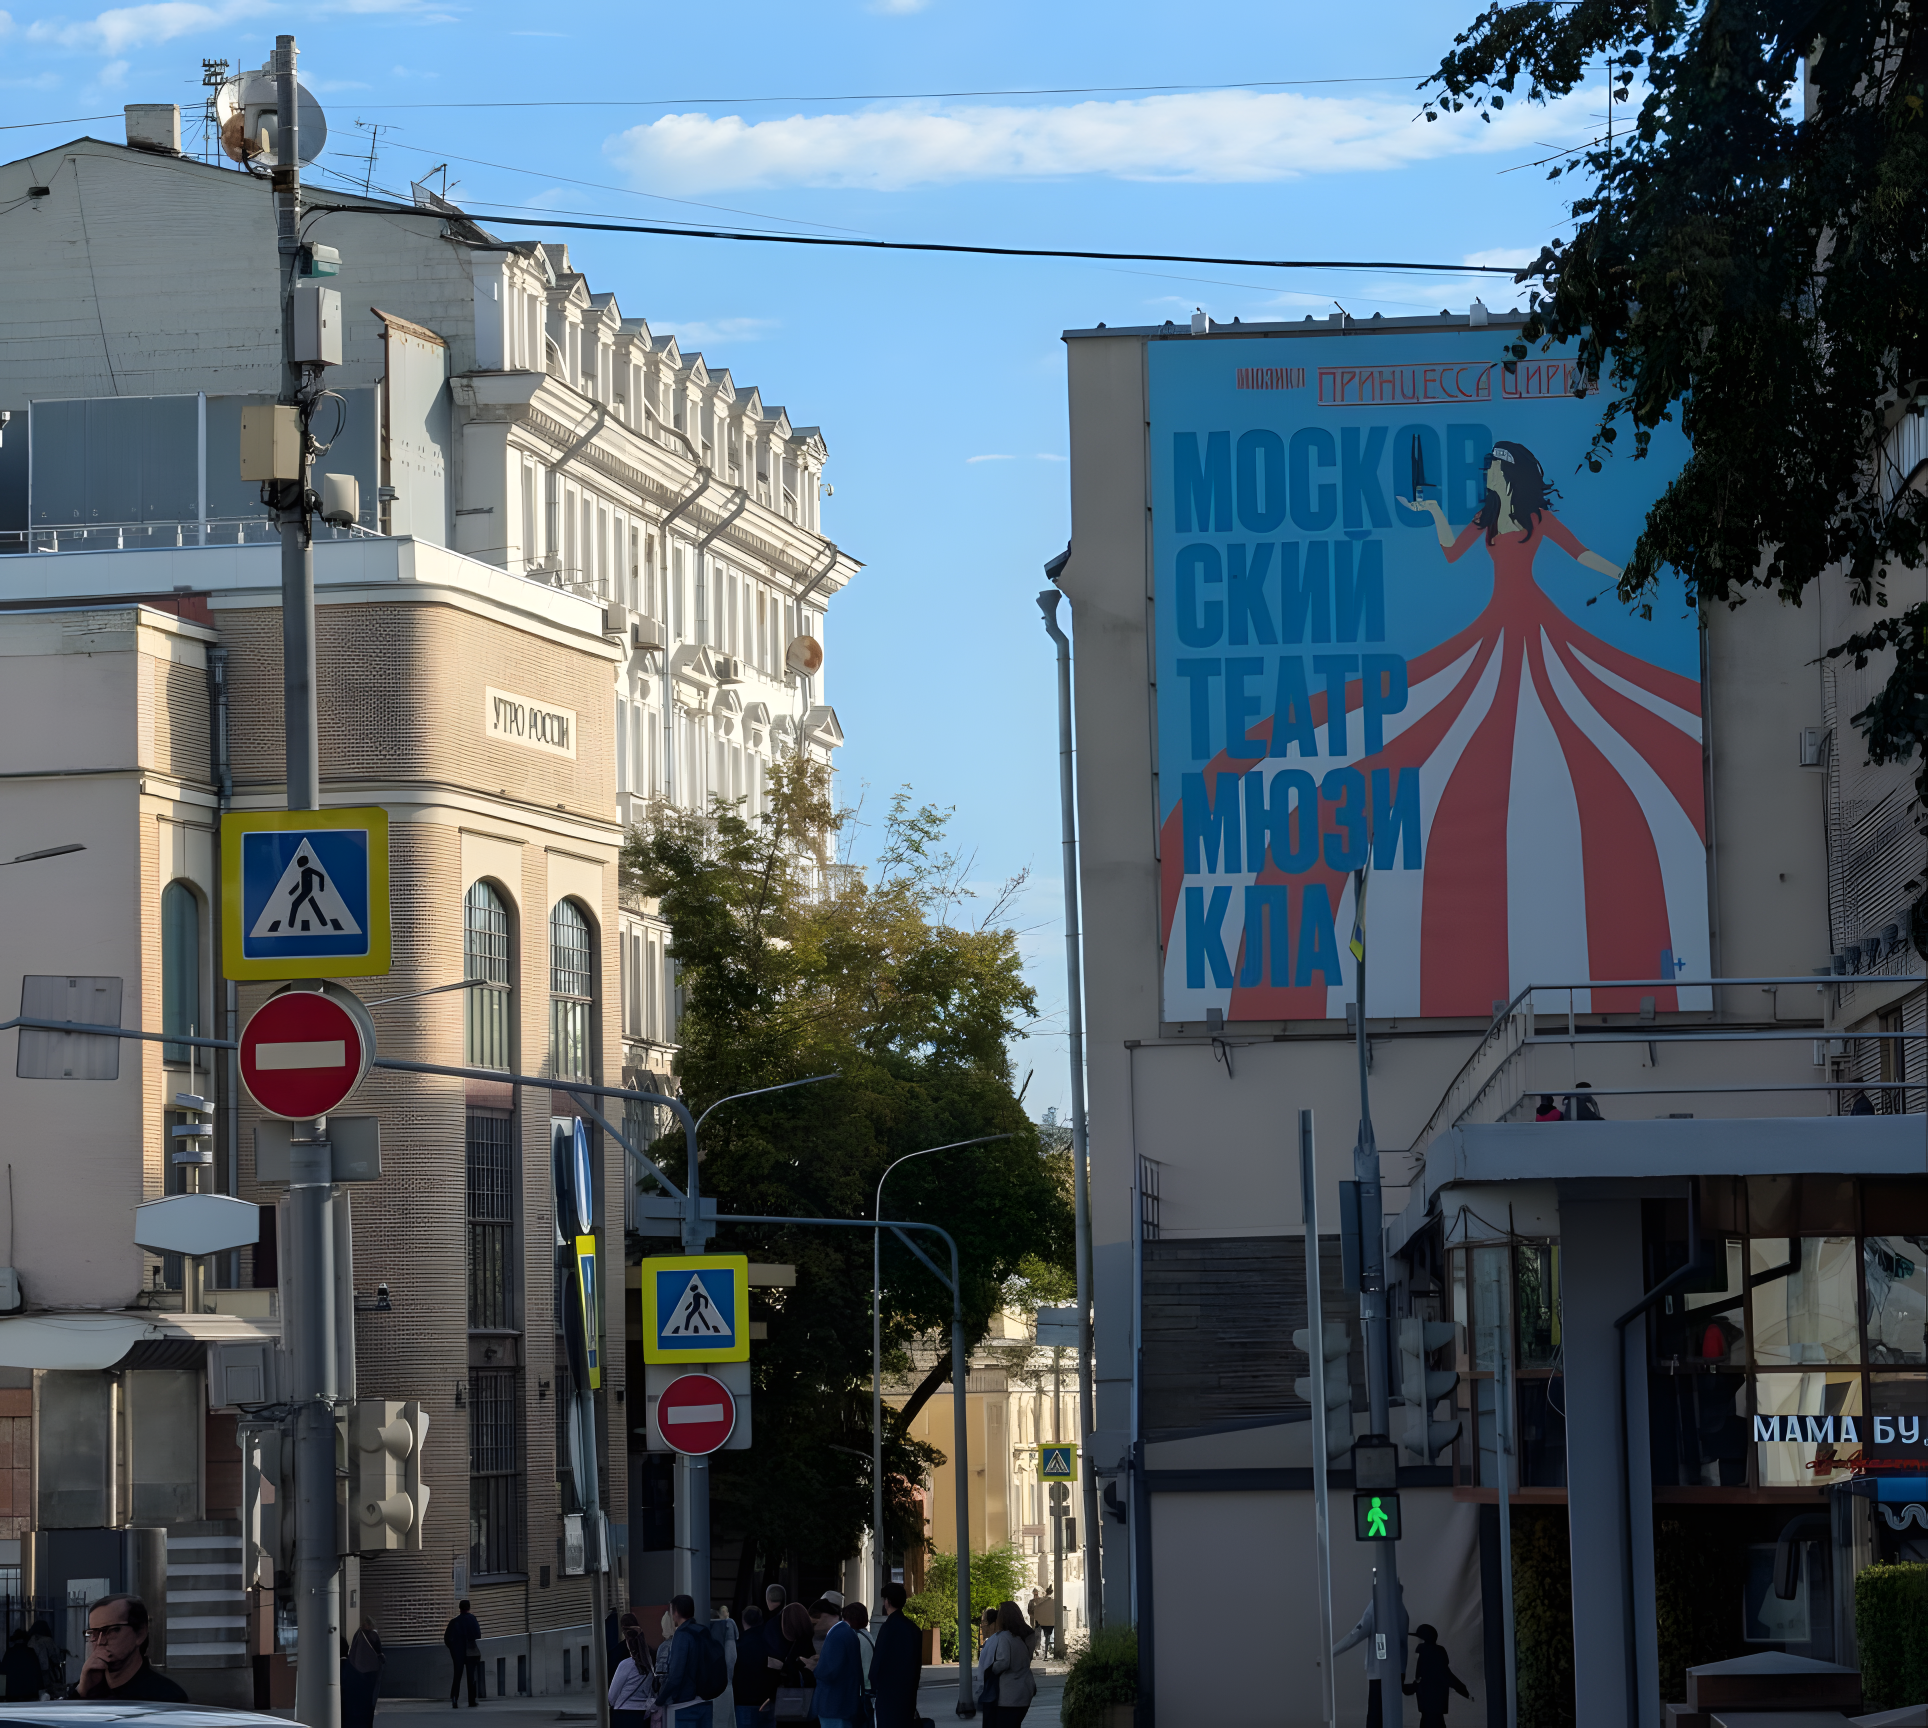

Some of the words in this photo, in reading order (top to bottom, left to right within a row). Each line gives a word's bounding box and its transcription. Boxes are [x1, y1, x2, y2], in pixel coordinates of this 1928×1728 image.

[1318, 362, 1491, 402] ПРИНЦЕССА
[1173, 424, 1492, 533] МОСКОВ
[1176, 530, 1385, 648] СКИЙ
[493, 696, 525, 736] УТРО
[1177, 653, 1408, 760] ТЕАТР
[1181, 766, 1422, 874] МЮЗИ
[1185, 883, 1343, 988] КЛА
[1754, 1416, 1858, 1442] МАМА
[1874, 1416, 1928, 1447] БУ
